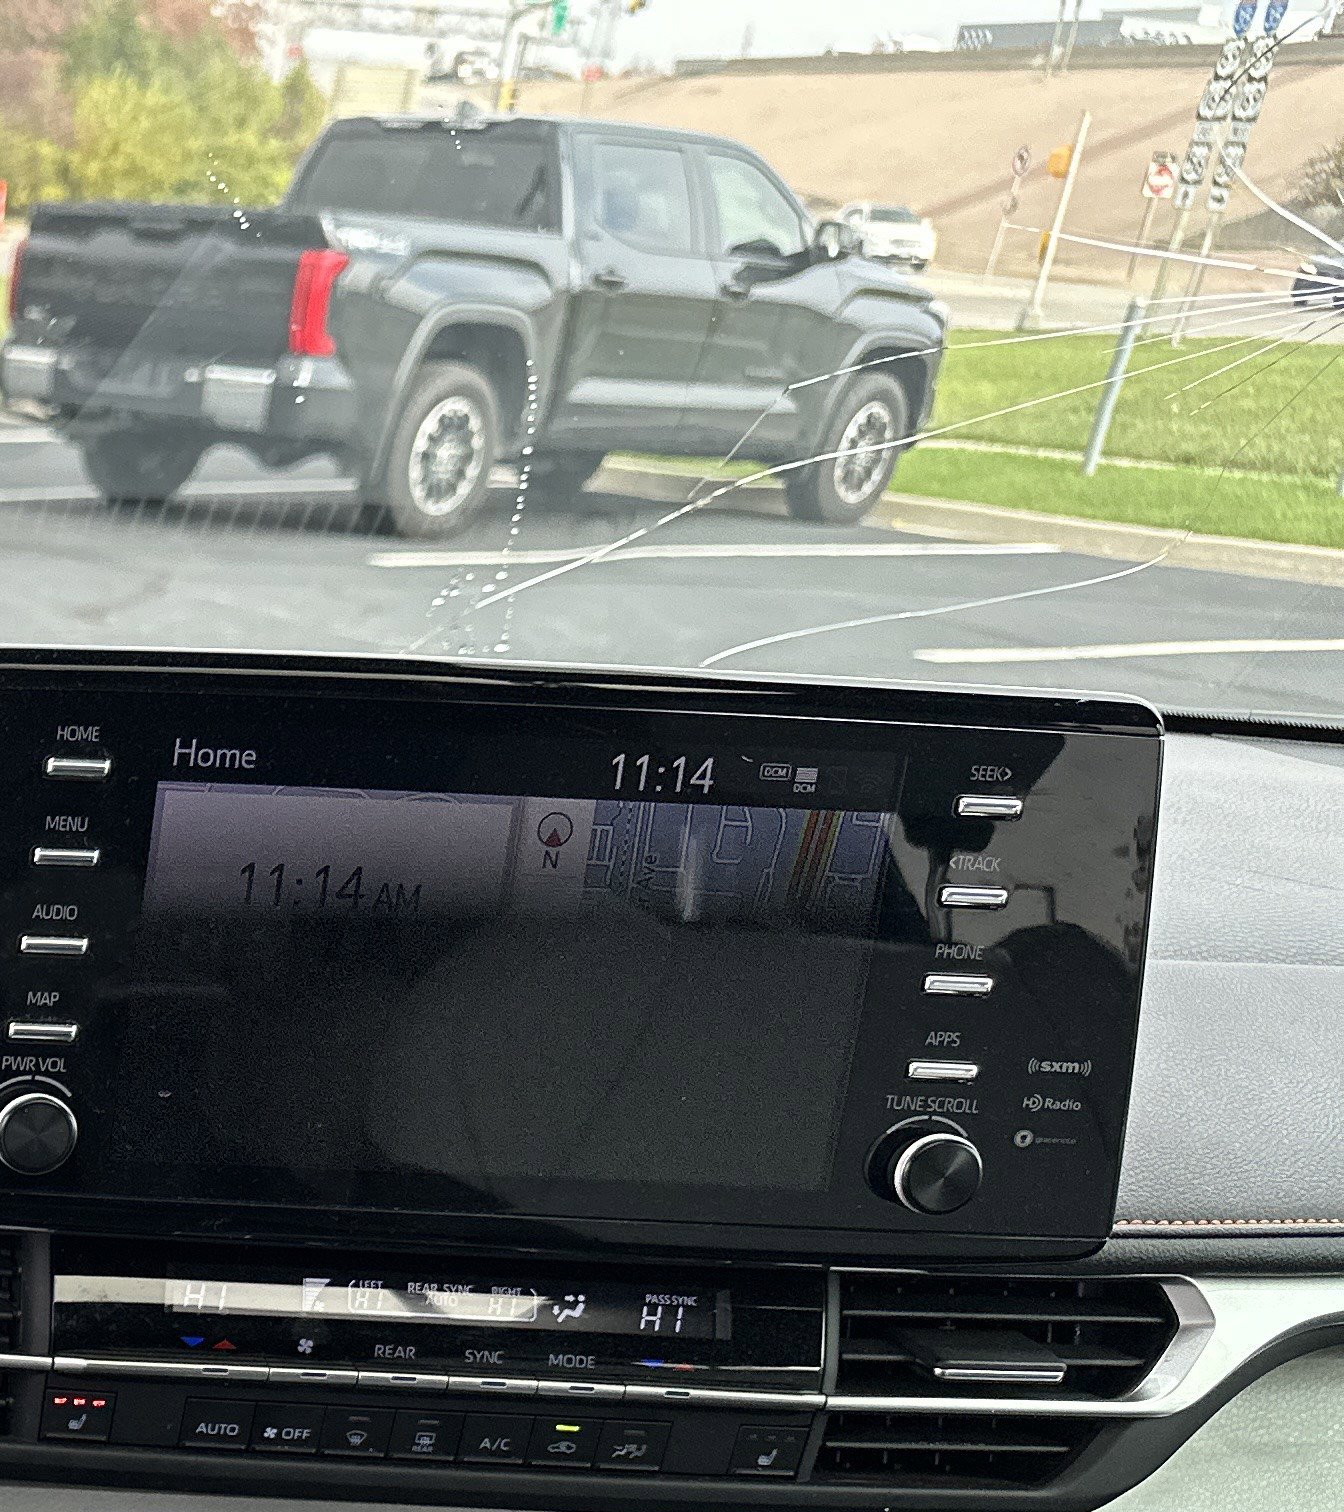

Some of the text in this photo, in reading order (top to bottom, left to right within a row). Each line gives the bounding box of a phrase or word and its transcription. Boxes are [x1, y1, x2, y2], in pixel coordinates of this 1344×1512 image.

[56, 725, 101, 743] HOME
[173, 738, 257, 769] Home
[611, 753, 715, 796] 11:14
[45, 815, 89, 832] MENU
[542, 850, 560, 870] N
[957, 855, 1001, 872] TRACK
[238, 860, 423, 913] 11:14 AM
[32, 905, 78, 921] AUDIO
[935, 944, 984, 961] PHONE
[26, 991, 60, 1006] MAP
[925, 1032, 961, 1047] APPS
[1, 1056, 68, 1073] PWR VOL
[886, 1095, 979, 1115] TUNE SCROLL
[1044, 1097, 1082, 1111] Radio
[645, 1293, 699, 1307] PASS SYNC
[374, 1344, 416, 1360] REAR
[464, 1349, 505, 1364] SYNC
[548, 1353, 596, 1369] MODE
[196, 1421, 240, 1437] AUTO
[281, 1427, 311, 1441] OFF
[480, 1436, 511, 1452] A/C
